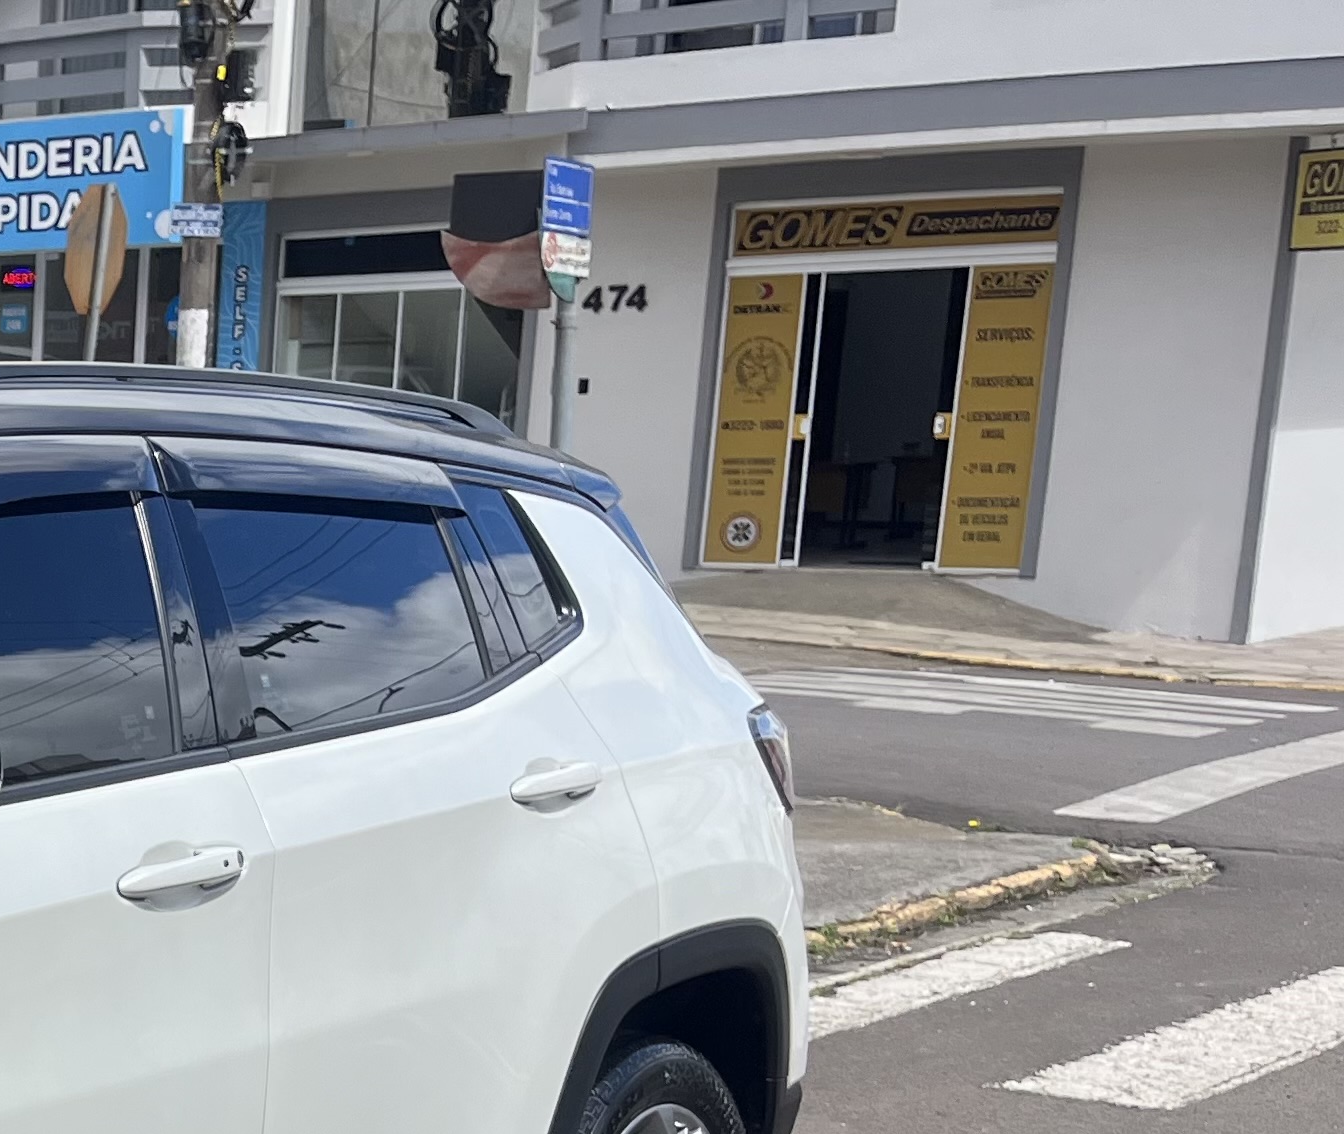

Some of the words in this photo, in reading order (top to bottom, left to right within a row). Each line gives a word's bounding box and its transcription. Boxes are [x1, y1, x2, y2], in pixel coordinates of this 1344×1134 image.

[1305, 162, 1344, 195] GO
[740, 204, 904, 250] GOMES
[911, 210, 1054, 237] Despachante
[582, 283, 649, 314] 474
